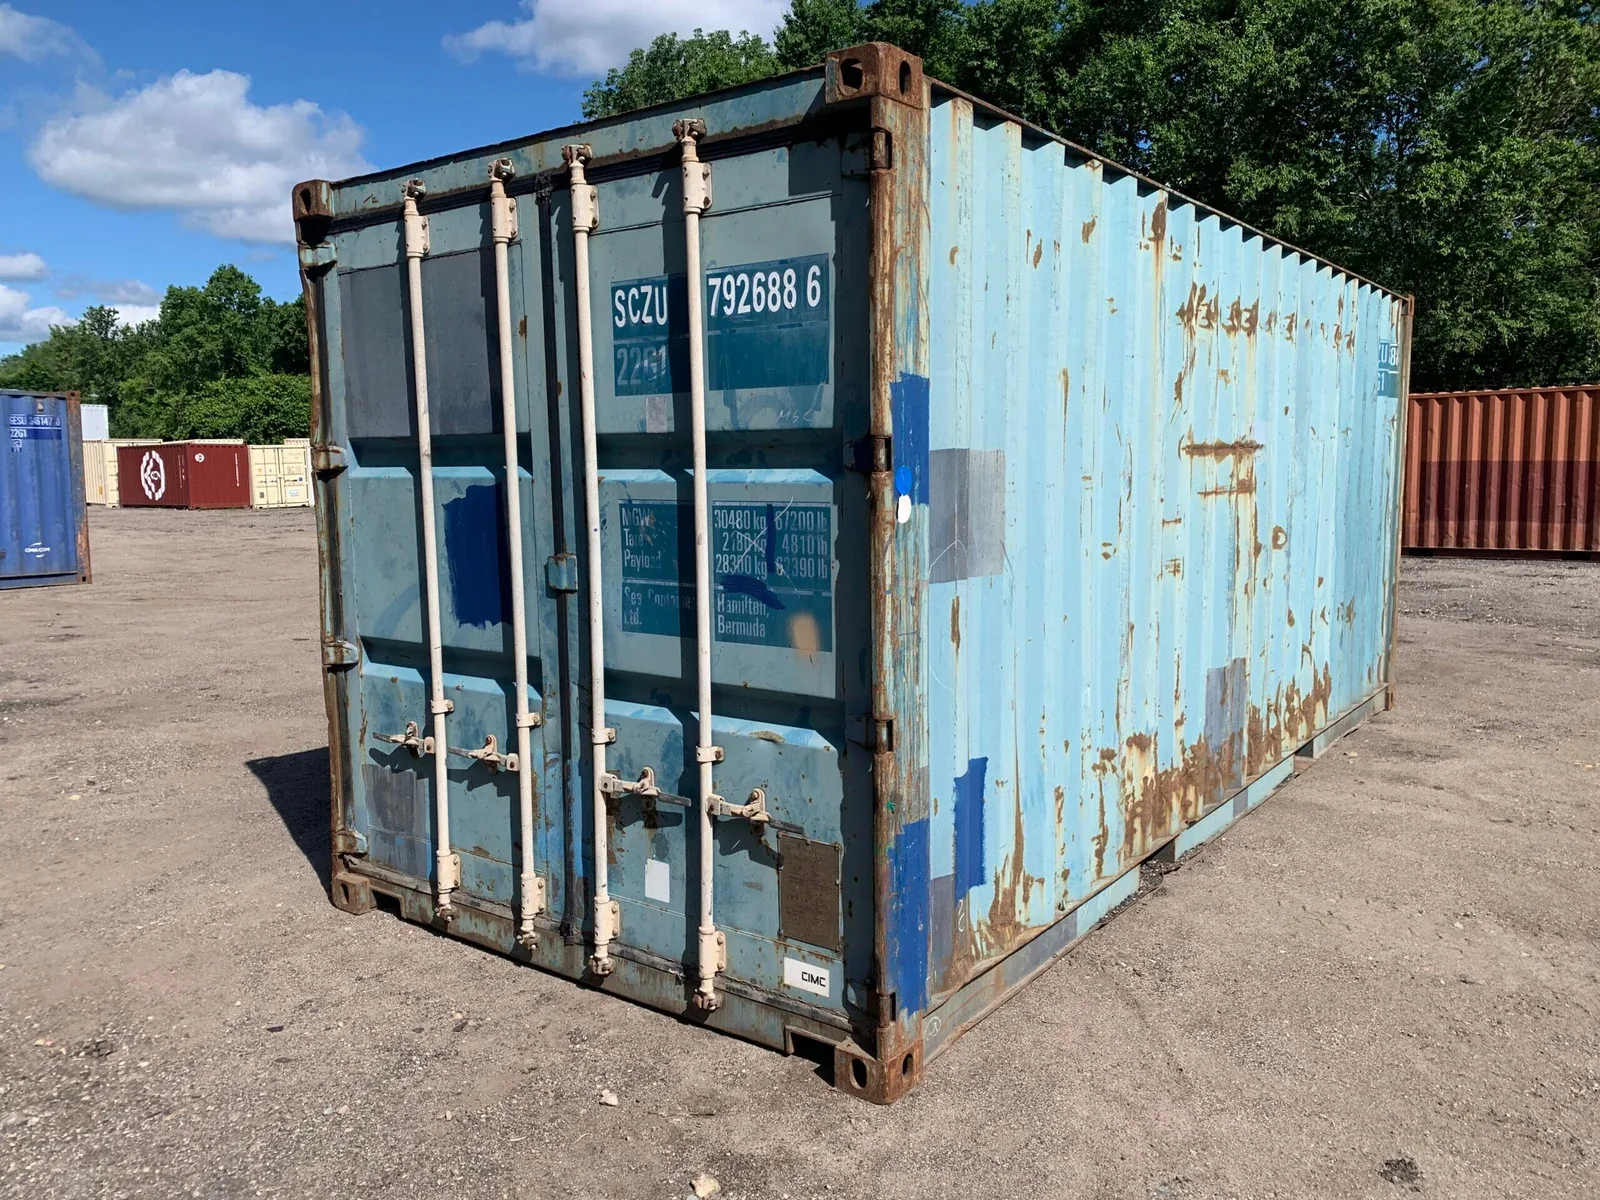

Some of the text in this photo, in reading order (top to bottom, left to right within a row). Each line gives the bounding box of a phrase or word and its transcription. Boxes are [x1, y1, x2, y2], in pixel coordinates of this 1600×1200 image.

[614, 264, 821, 328] SCZU 792688 6
[617, 345, 666, 386] 22G1
[714, 510, 751, 530] 30480
[753, 510, 767, 533] kg
[775, 511, 815, 531] 67200
[817, 511, 828, 532] lb
[623, 528, 644, 547] Tare
[722, 532, 752, 552] 2180
[782, 534, 815, 555] 4810
[817, 536, 828, 556] lb
[624, 549, 828, 580] Payload 28300 kg 62390 lb
[717, 594, 770, 618] Hamilton,
[717, 614, 766, 637] Bermuda
[801, 971, 826, 988] CIMC
